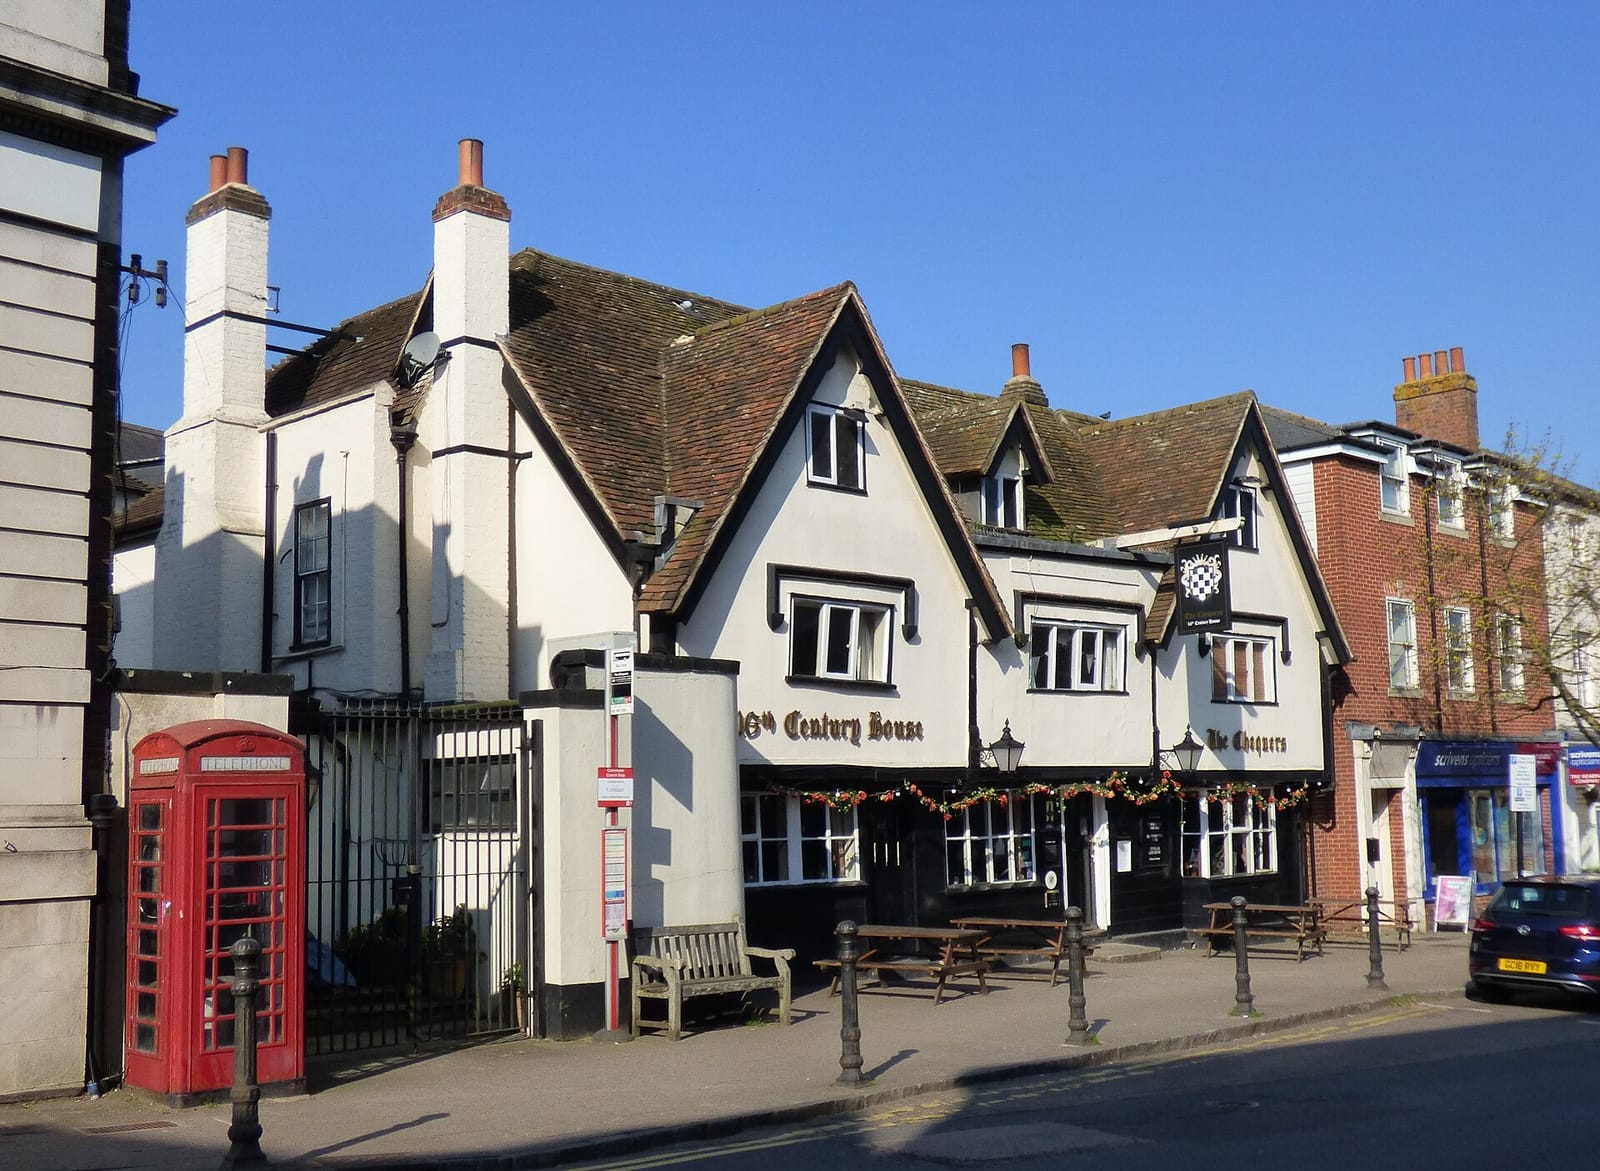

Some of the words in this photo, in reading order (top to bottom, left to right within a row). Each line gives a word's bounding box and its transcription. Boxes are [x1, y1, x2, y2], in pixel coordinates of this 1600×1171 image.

[783, 710, 862, 748] Century
[867, 711, 925, 742] House
[1232, 730, 1287, 759] Chequers
[202, 758, 287, 770] TELEPHONE
[1434, 751, 1470, 767] scrivens
